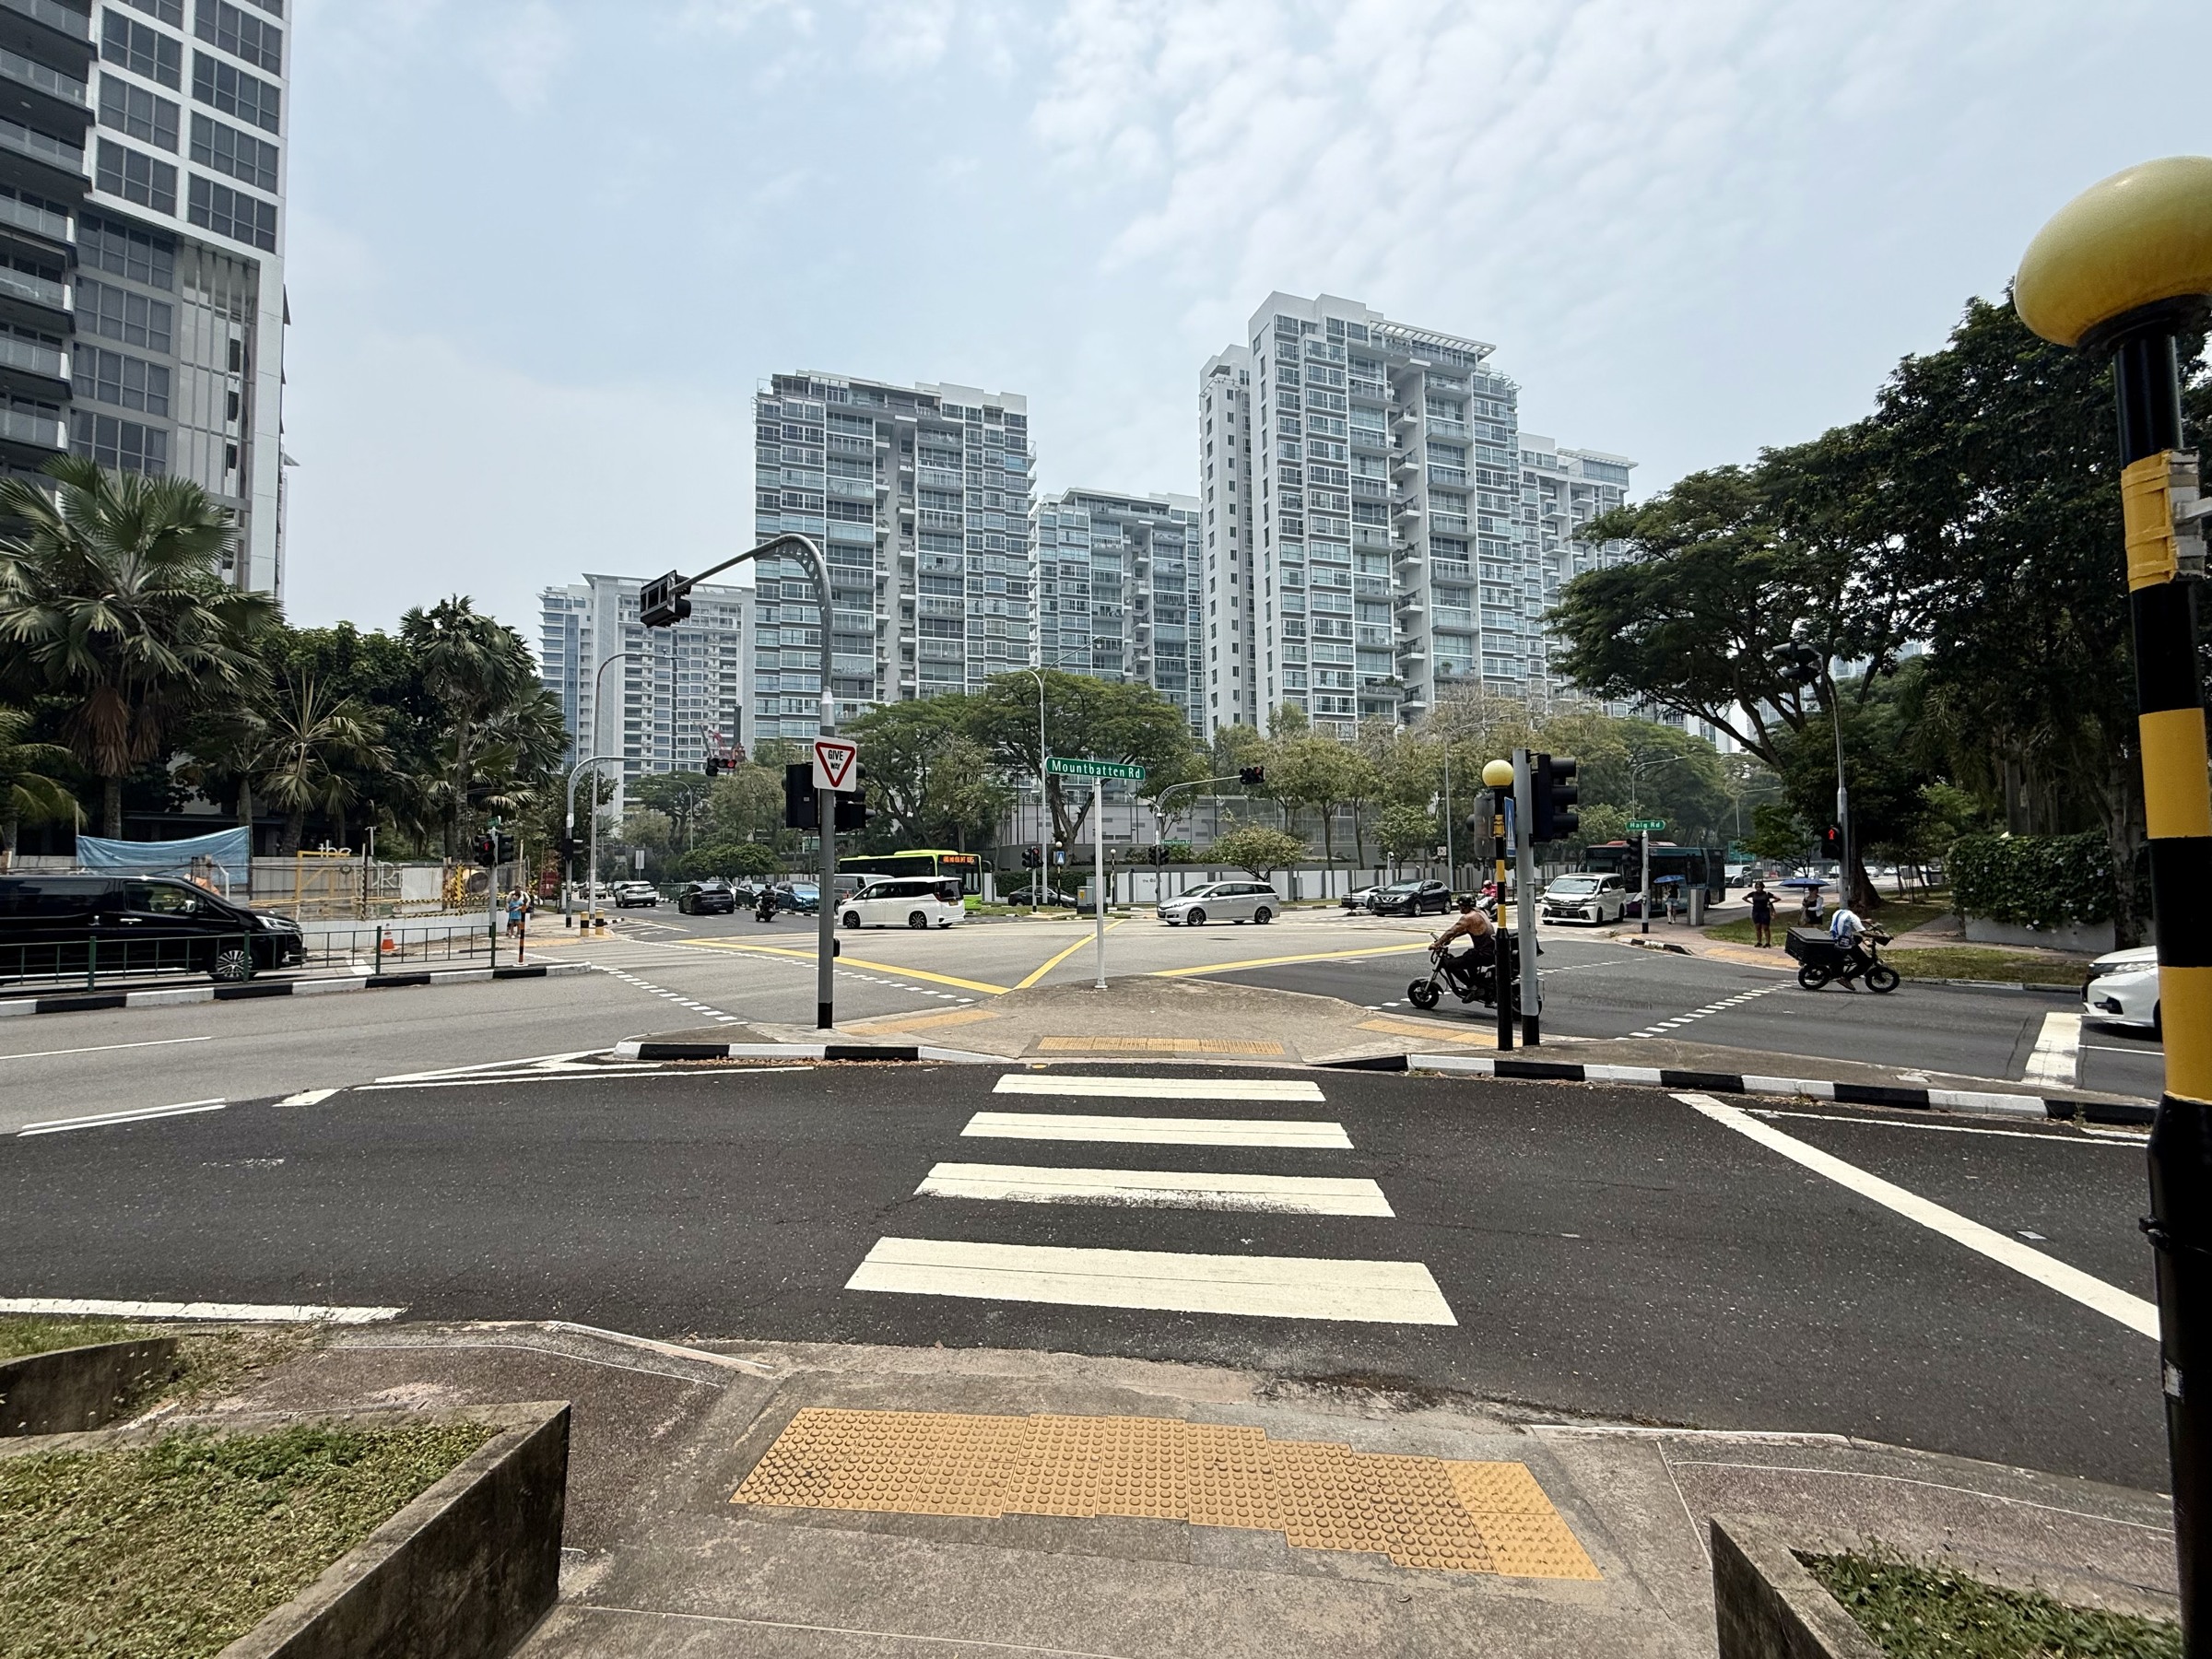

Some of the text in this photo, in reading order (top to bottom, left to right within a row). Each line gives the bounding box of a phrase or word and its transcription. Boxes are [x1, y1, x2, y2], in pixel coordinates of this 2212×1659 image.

[828, 749, 843, 761] GIVE
[830, 762, 841, 771] WAY
[1052, 759, 1140, 779] Mountbatten Rd
[1630, 821, 1648, 830] Haig
